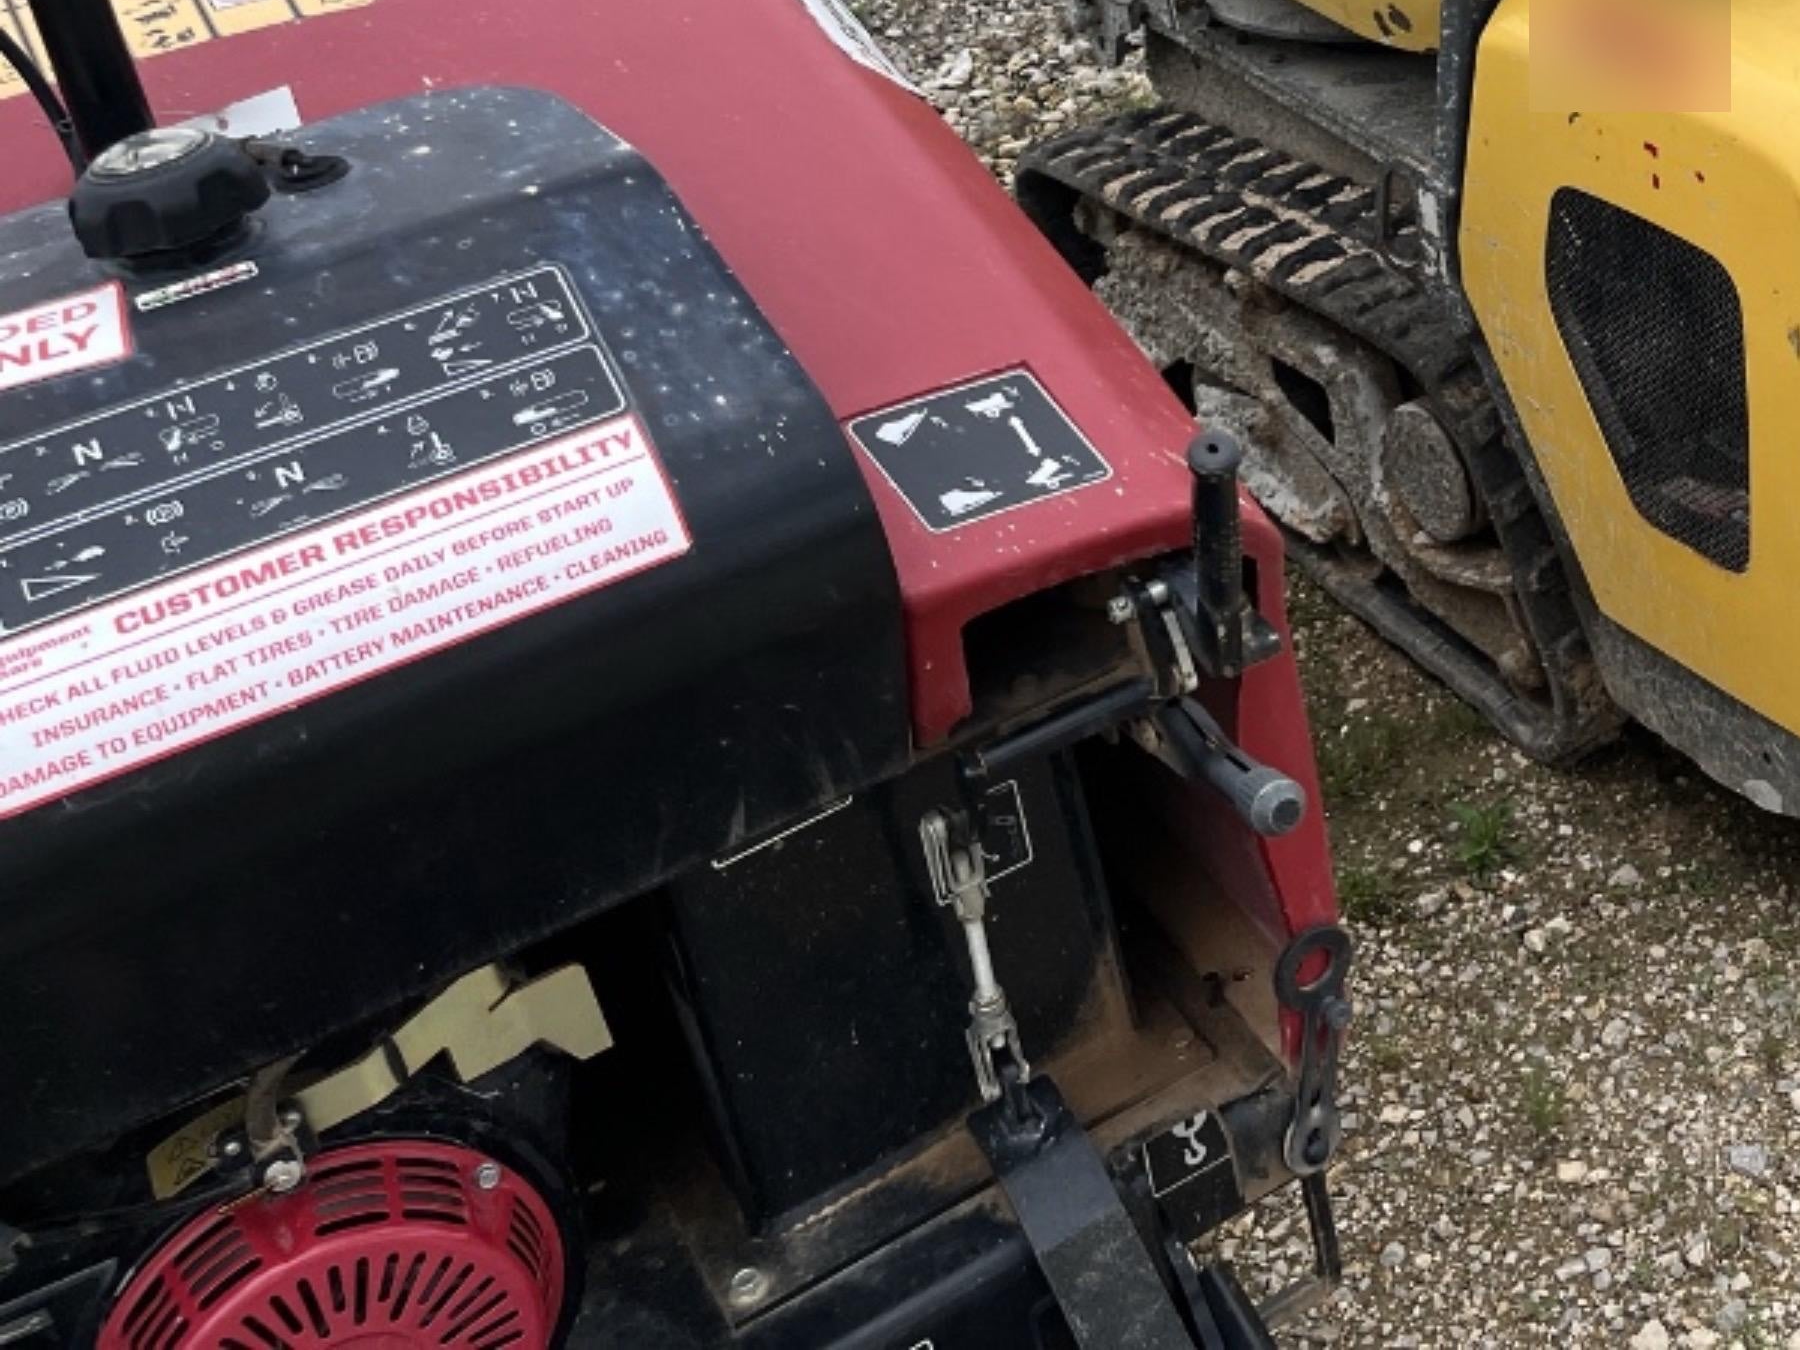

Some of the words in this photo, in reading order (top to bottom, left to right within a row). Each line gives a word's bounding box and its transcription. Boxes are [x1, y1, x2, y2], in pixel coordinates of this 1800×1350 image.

[32, 683, 169, 748] INSURANCE
[186, 653, 239, 691] FLAT
[243, 629, 313, 668] TIRES
[329, 604, 385, 635] TIRE
[388, 566, 480, 613] DAMAGE
[497, 517, 613, 573] REFUELING
[66, 676, 108, 702] ALL
[110, 647, 181, 685] FLUID
[185, 615, 267, 658] LEVELS
[292, 572, 379, 617] GREASE
[383, 547, 446, 583] DAILY
[451, 515, 534, 557] BEFORE
[536, 488, 602, 524] START
[605, 476, 635, 500] UP
[97, 737, 128, 760] TO
[131, 681, 268, 747] EQUIPMENT
[287, 637, 385, 687] BATTERY
[390, 574, 550, 648] MAINTENANCE
[563, 528, 669, 581] CLEANING
[113, 543, 327, 635] CUSTOMER
[332, 429, 634, 556] RESPONSIBILITY
